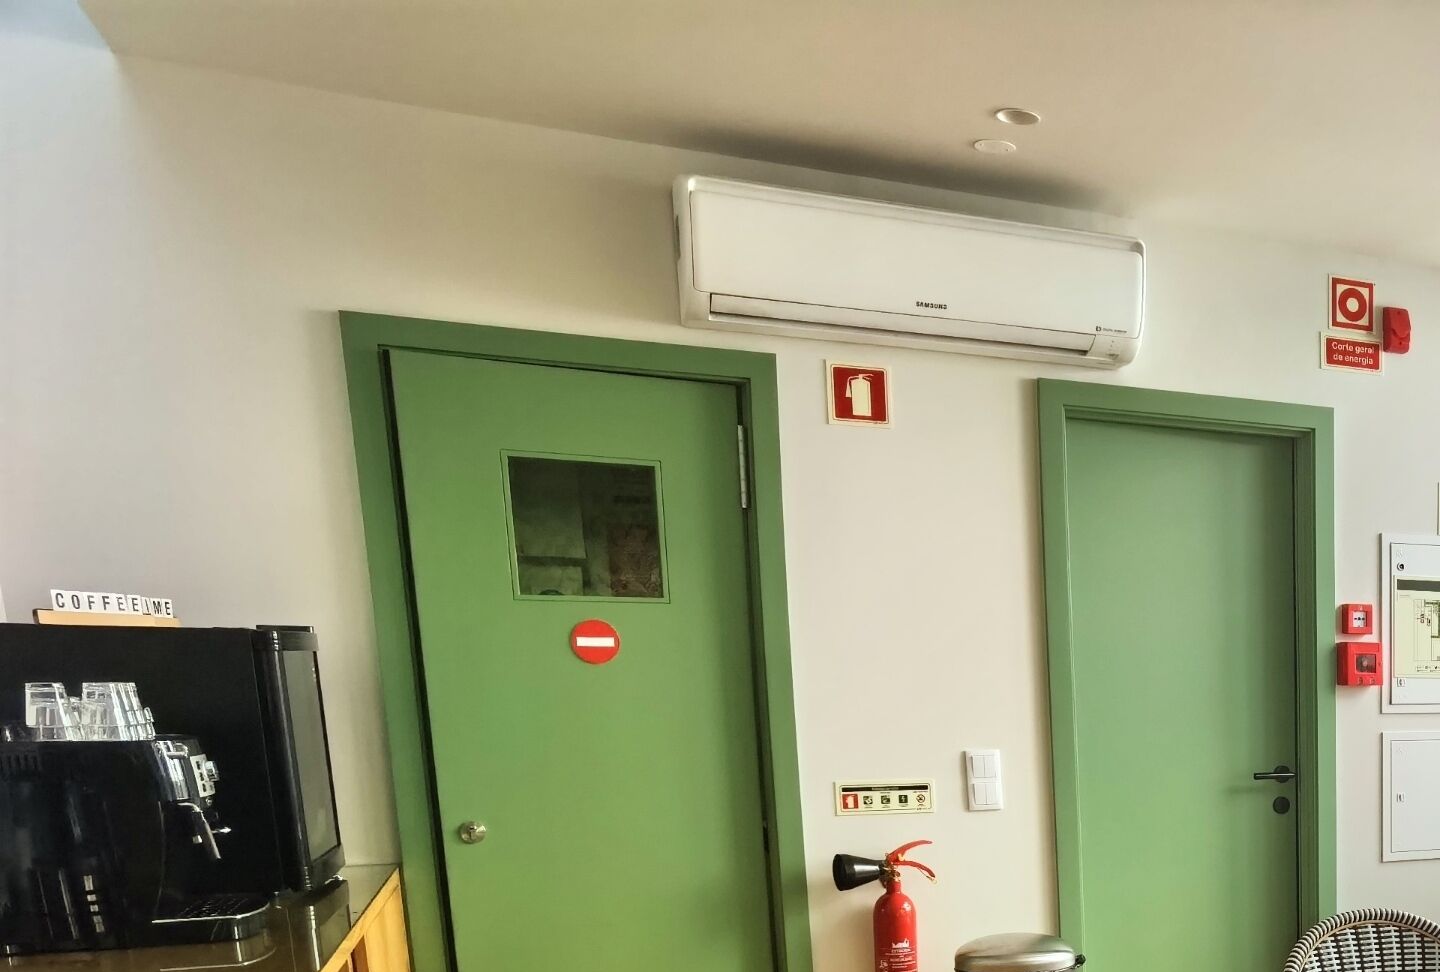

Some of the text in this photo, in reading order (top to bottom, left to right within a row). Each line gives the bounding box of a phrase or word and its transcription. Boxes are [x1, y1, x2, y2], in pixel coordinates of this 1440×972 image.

[916, 301, 948, 310] SAMSUNG
[1331, 341, 1375, 354] Corte geral
[1333, 353, 1374, 366] de energia
